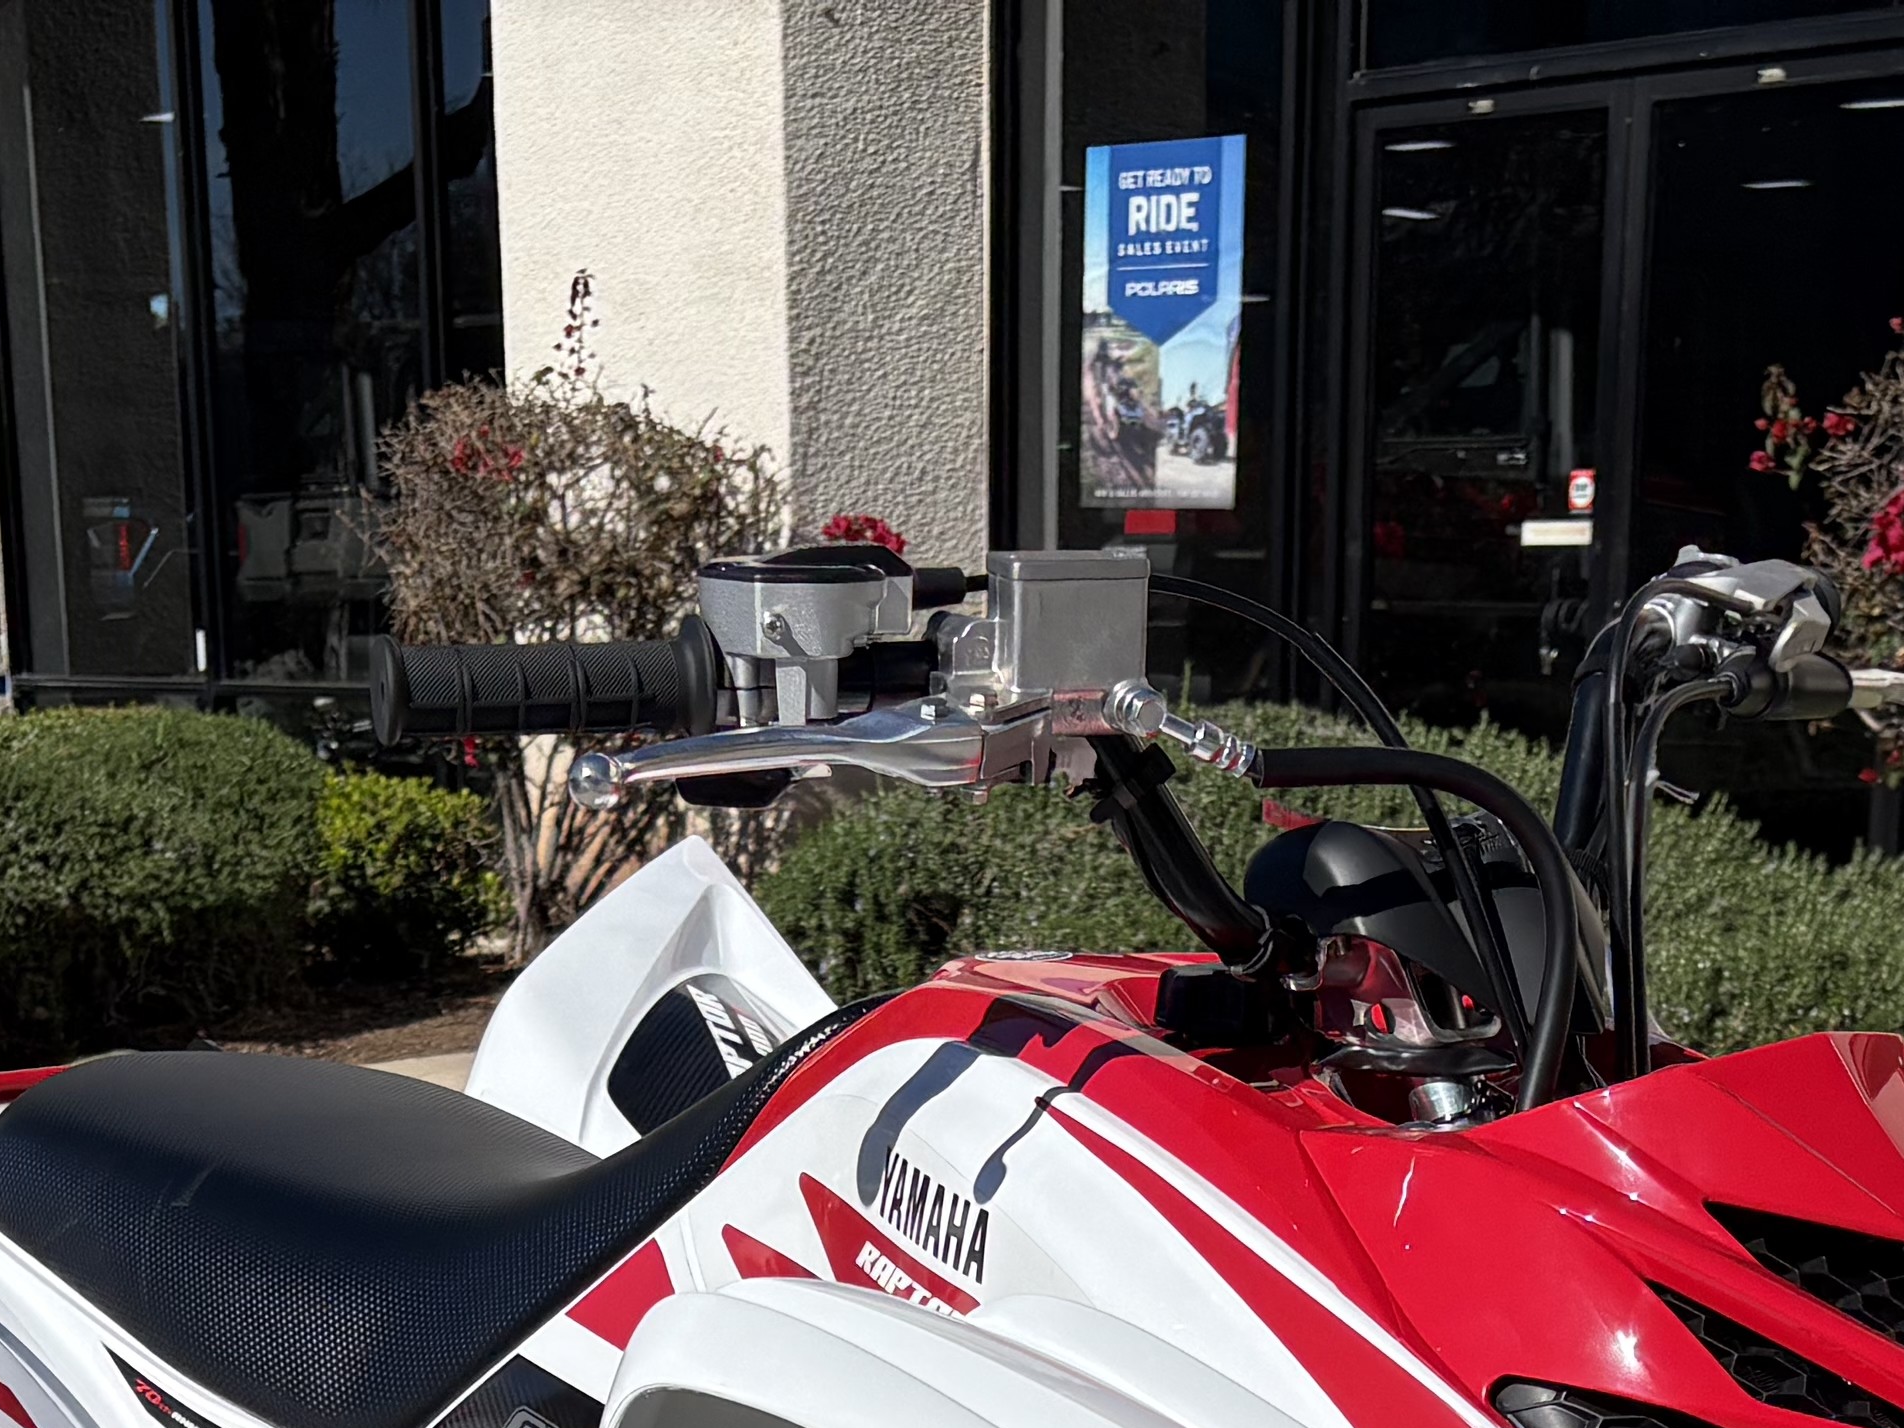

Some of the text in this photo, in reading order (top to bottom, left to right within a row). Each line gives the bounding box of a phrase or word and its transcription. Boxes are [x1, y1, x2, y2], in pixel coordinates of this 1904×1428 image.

[1119, 166, 1213, 190] GET READY TO
[1128, 192, 1200, 236] RIDE
[1117, 239, 1208, 257] SALES EVENT
[1125, 279, 1200, 297] POLARIS
[879, 1145, 990, 1285] YAMAHA
